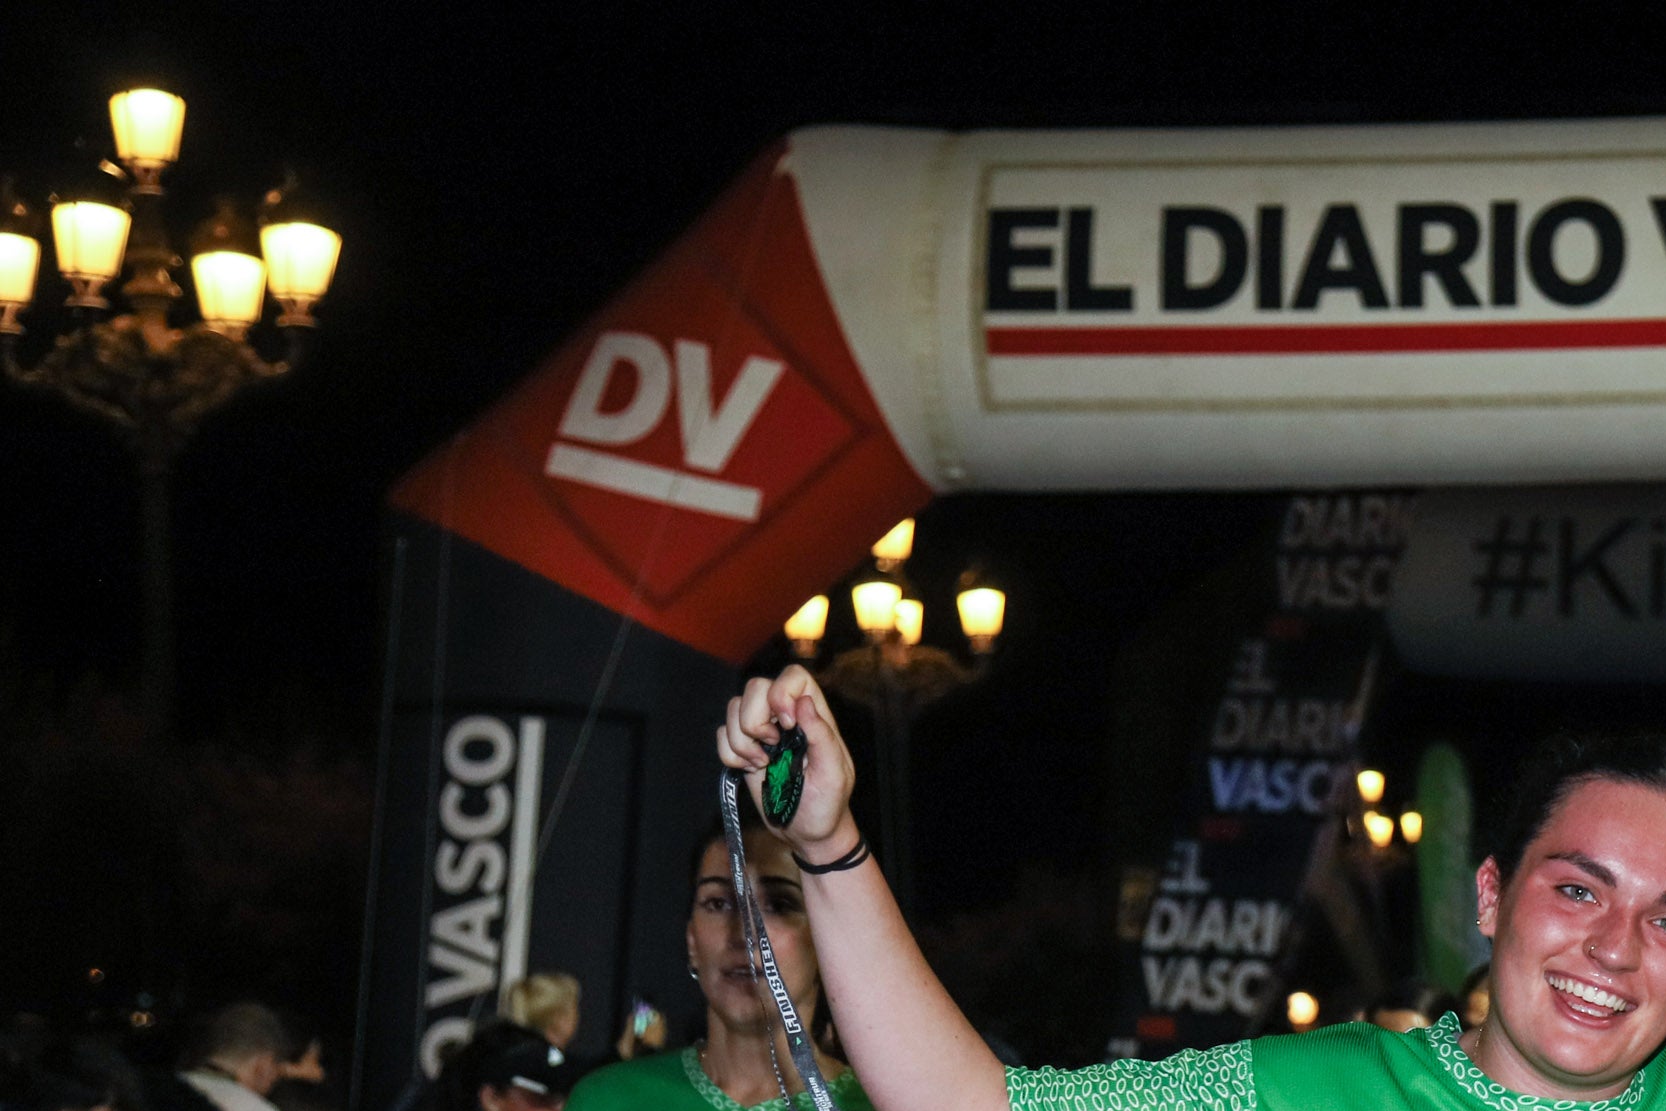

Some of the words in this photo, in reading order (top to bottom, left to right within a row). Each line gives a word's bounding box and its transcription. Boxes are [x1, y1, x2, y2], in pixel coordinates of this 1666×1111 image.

[983, 205, 1134, 315] EL
[1158, 195, 1628, 313] DIARIO
[556, 331, 788, 474] DV
[1279, 497, 1406, 547] DIARI
[1277, 556, 1398, 608] VASC
[1210, 701, 1352, 751] DIARI
[1207, 757, 1342, 814] VASC
[424, 714, 517, 1007] VASCO
[1142, 897, 1290, 955] DIARI
[760, 936, 801, 1034] FINISHER
[1141, 955, 1276, 1016] VASC
